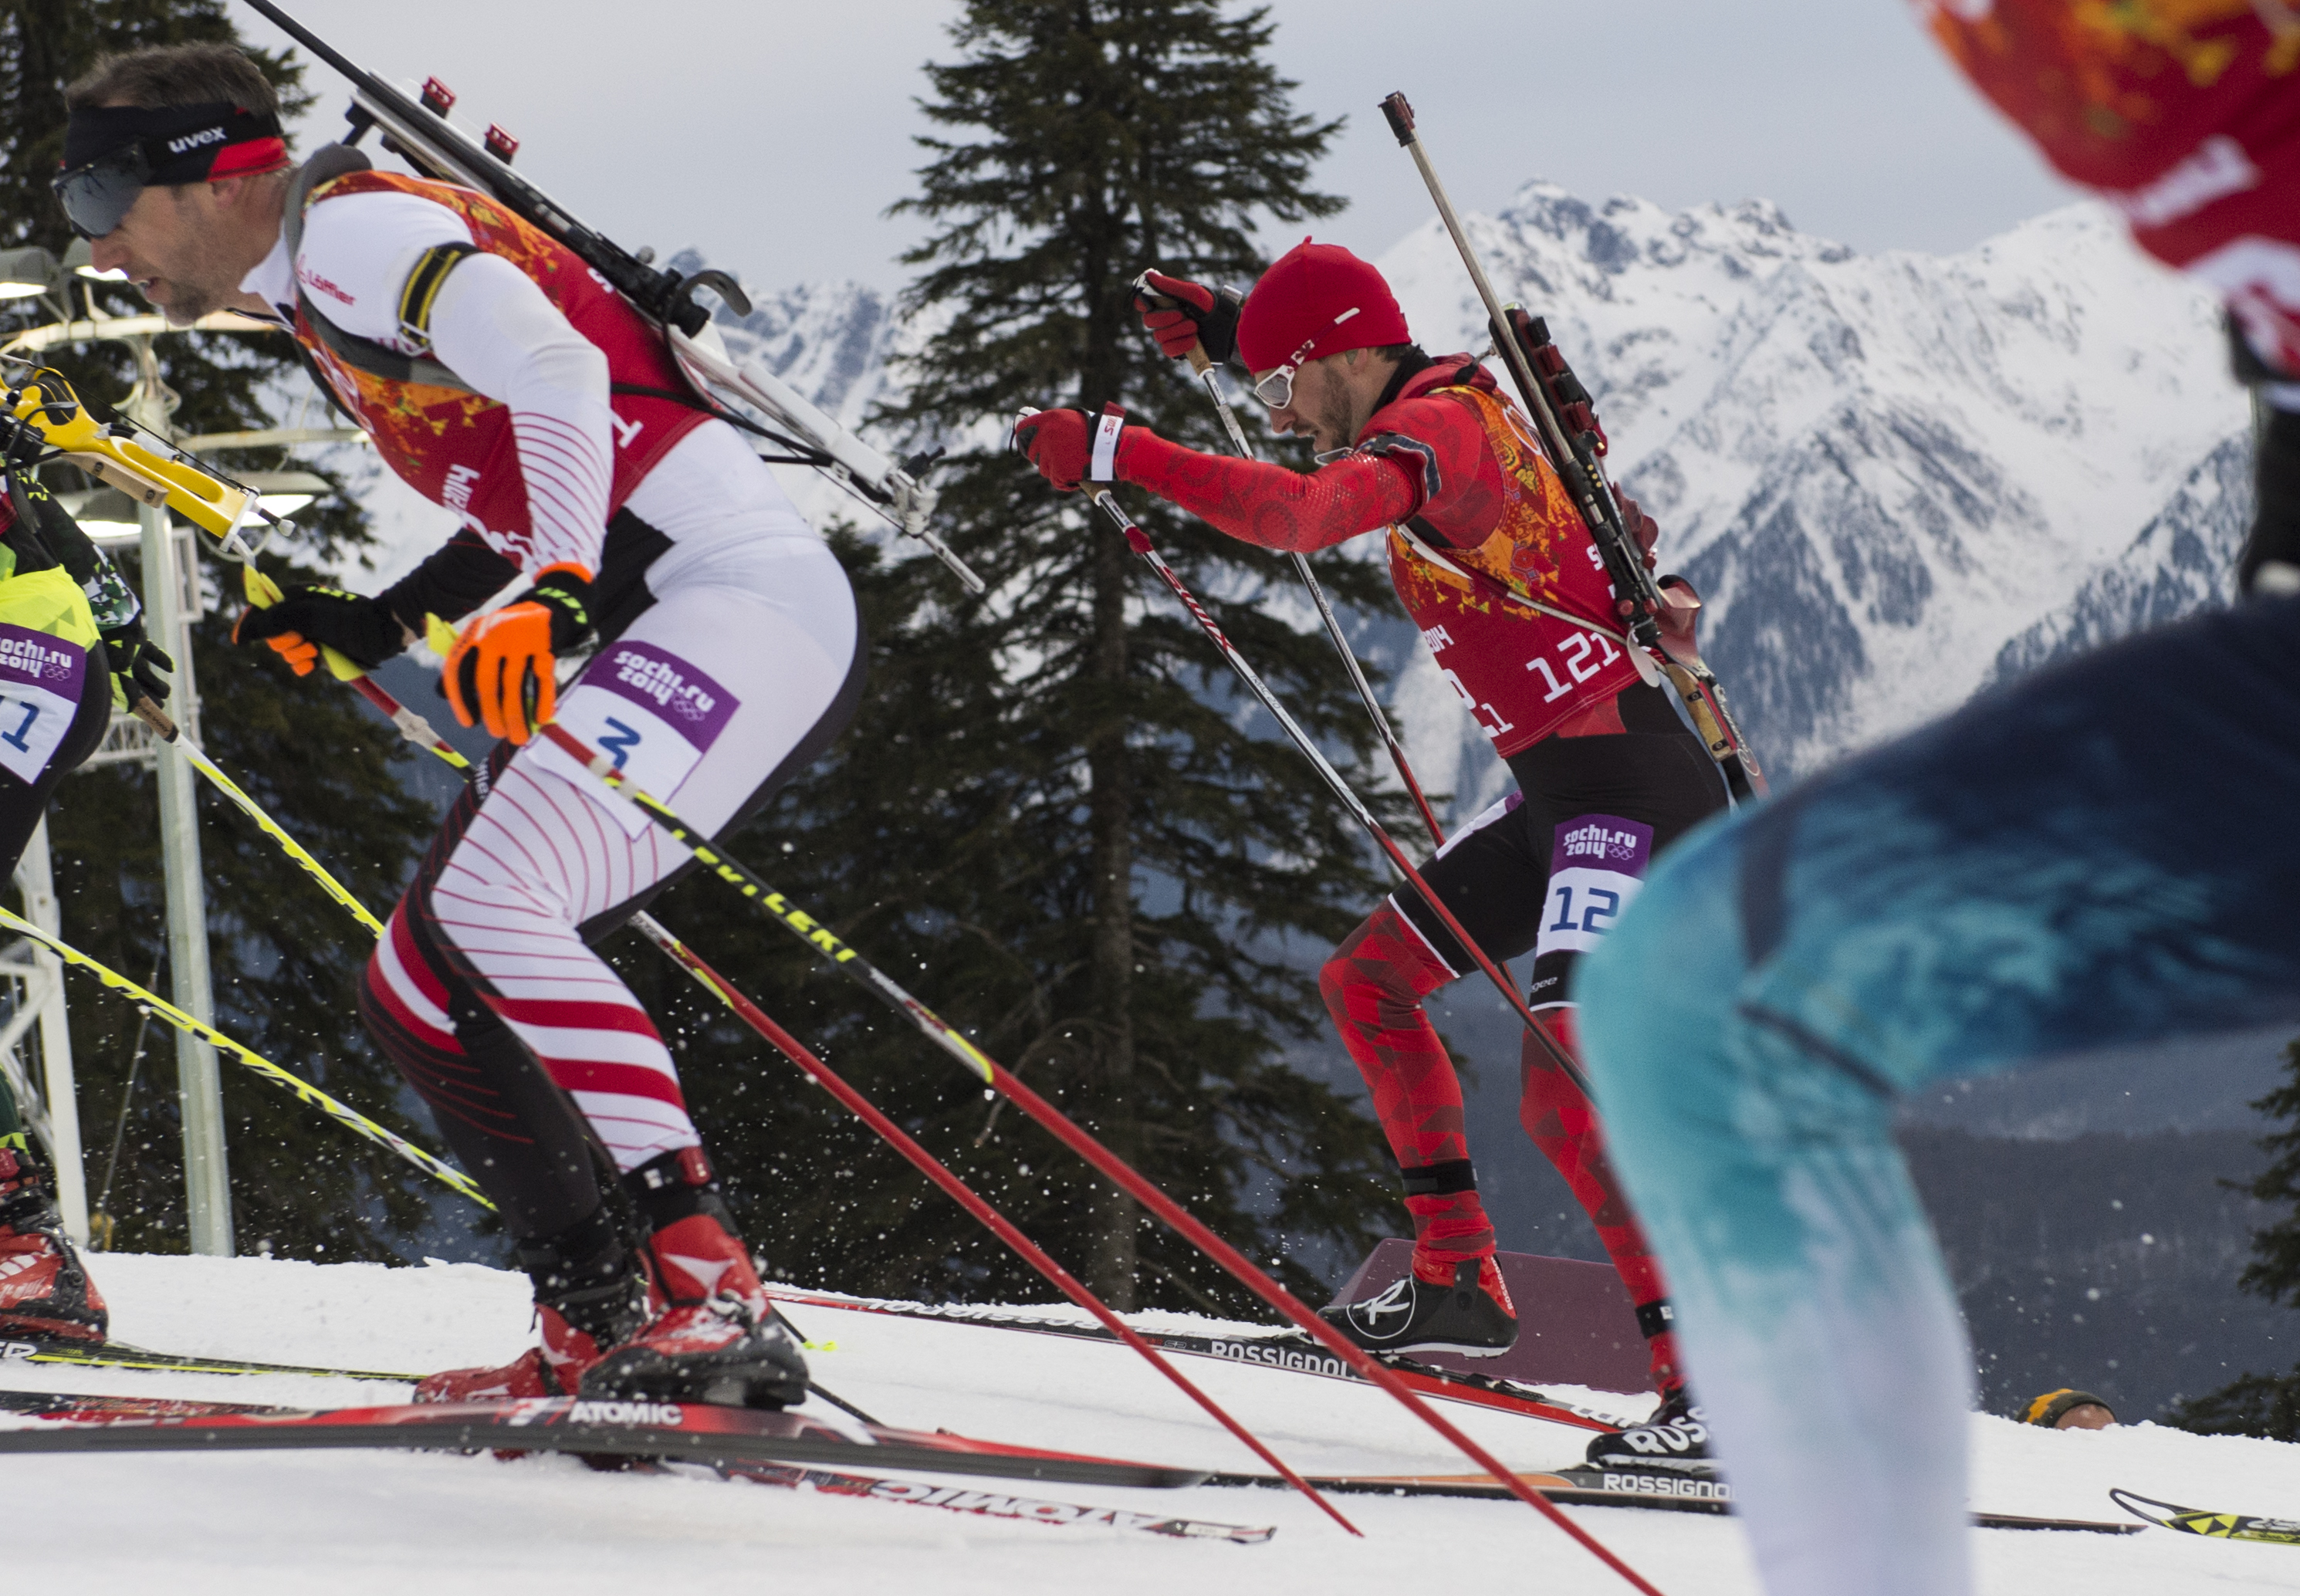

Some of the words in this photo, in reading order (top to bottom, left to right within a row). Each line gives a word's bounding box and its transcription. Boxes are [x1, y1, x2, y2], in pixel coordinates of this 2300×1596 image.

[167, 126, 227, 154] uvex
[613, 650, 716, 713] sochi.ru
[617, 665, 675, 707] 2014
[1563, 823, 1637, 848] sochi.ru
[1566, 840, 1607, 859] 2014
[1549, 886, 1620, 936] 12
[763, 892, 857, 962] LEKI
[568, 1401, 683, 1426] ATOMIC
[1603, 1473, 1734, 1501] ROSSIGNO
